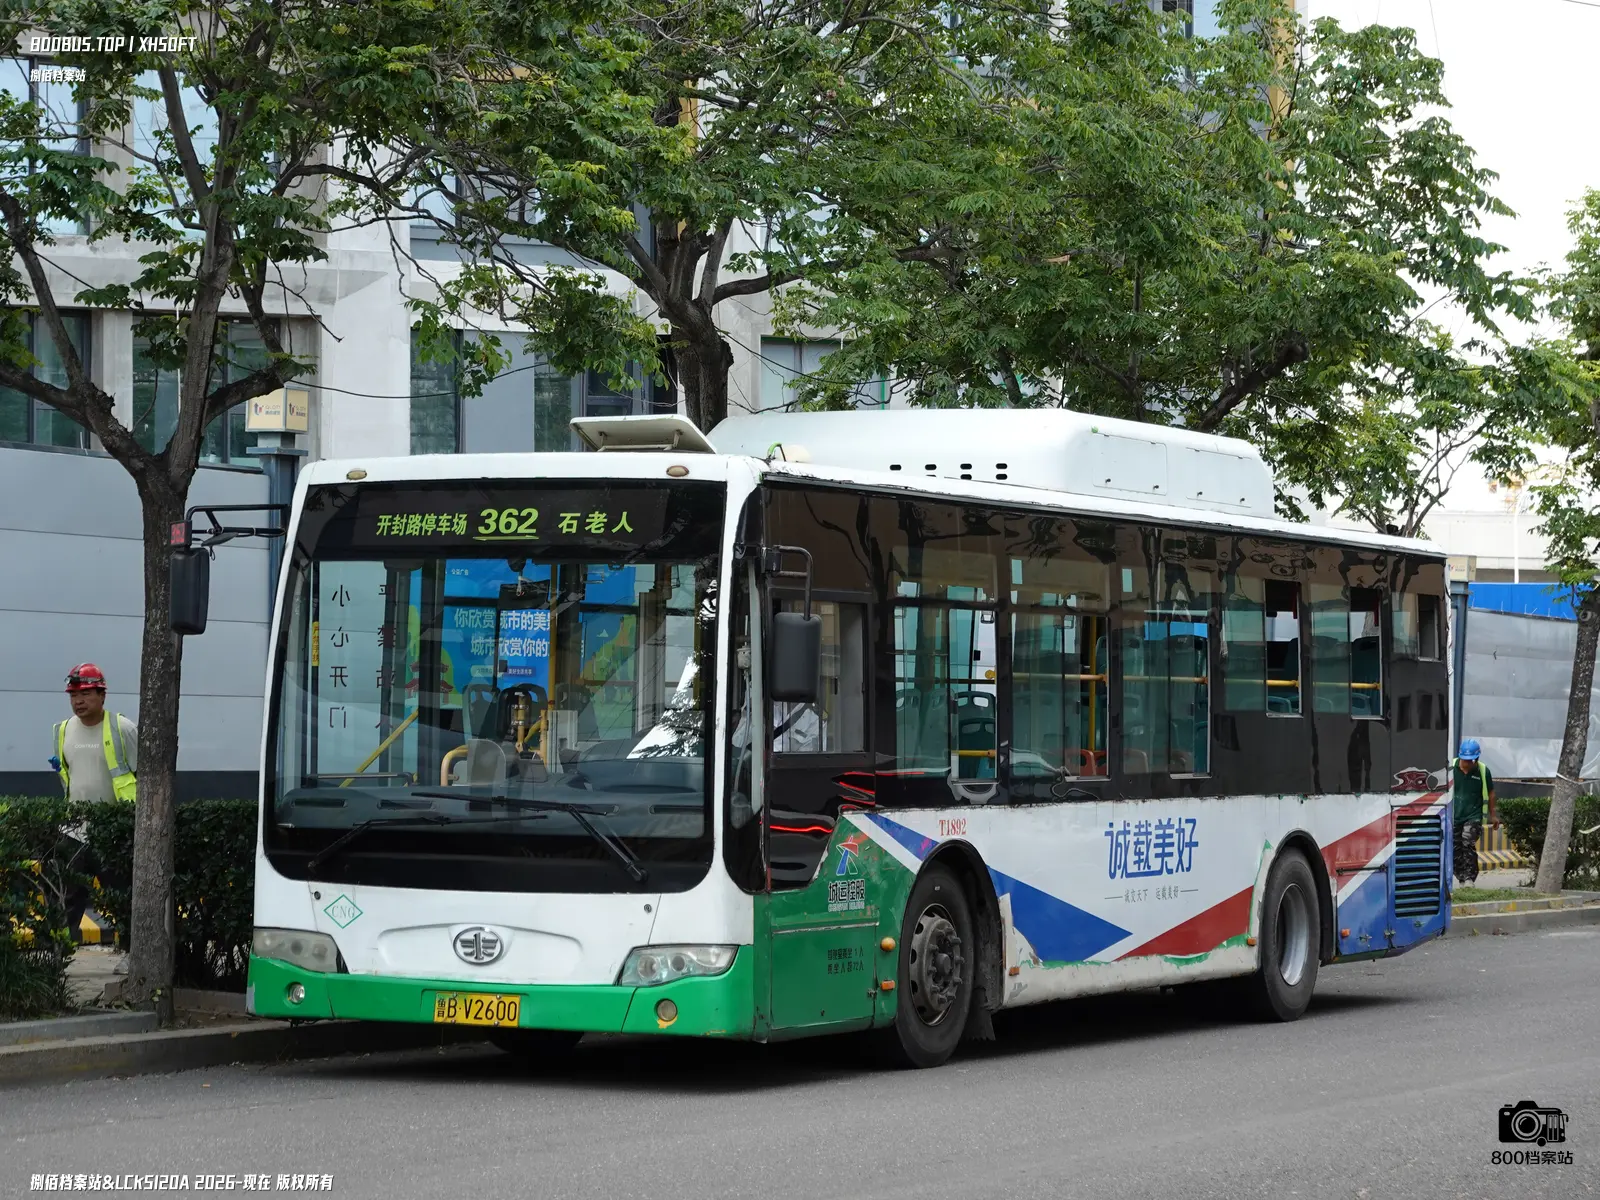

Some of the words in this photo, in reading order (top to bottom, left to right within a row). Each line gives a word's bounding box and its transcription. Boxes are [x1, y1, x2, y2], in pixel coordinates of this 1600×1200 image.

[376, 513, 468, 537] 开封路停车场
[477, 508, 539, 535] 362
[558, 511, 634, 534] 石老人
[454, 608, 551, 631] 你欣赏城市的美
[939, 818, 967, 837] T1892
[1104, 817, 1199, 879] 诚载美好
[828, 879, 866, 903] 城运控股
[331, 905, 355, 919] CNG
